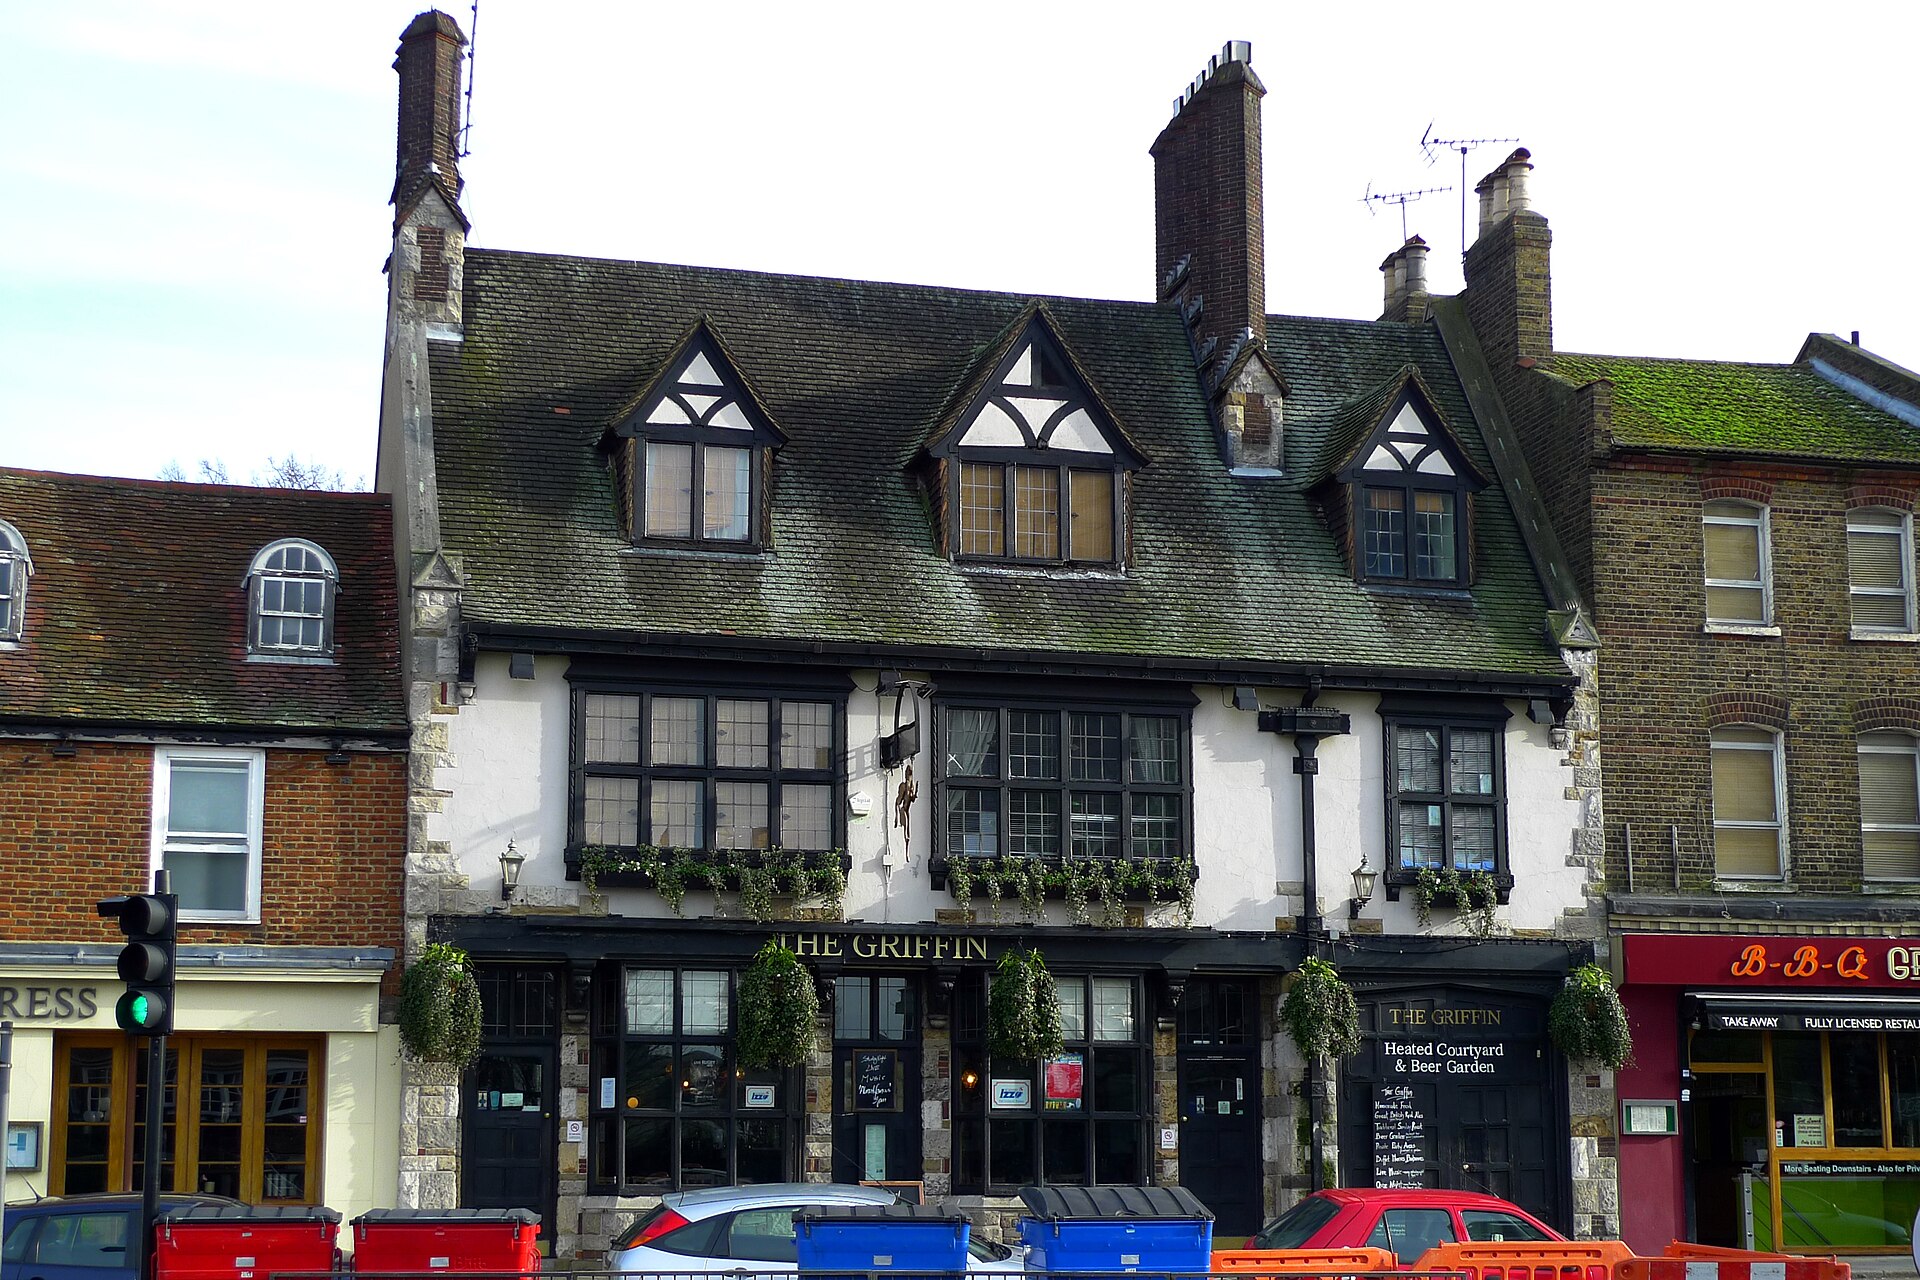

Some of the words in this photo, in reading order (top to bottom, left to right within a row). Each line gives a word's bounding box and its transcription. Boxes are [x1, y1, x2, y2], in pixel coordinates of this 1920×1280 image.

[778, 933, 842, 957] THE
[852, 935, 987, 960] GRIFFIN
[0, 986, 98, 1019] RESS
[1389, 1009, 1426, 1024] THE
[1431, 1009, 1501, 1025] GRIFFIN
[1722, 1016, 1748, 1027] TAKE
[1750, 1017, 1778, 1027] AWAY
[1805, 1018, 1833, 1028] FULLY
[1836, 1018, 1883, 1029] LICENSED
[1384, 1042, 1433, 1055] Heated
[1437, 1043, 1504, 1060] Courtyard
[1395, 1059, 1407, 1072] &
[1411, 1060, 1442, 1073] Beer
[1446, 1060, 1495, 1073] Garden
[1784, 1165, 1802, 1173] More
[1803, 1165, 1831, 1174] Seating
[1832, 1165, 1872, 1173] Downstairs
[1877, 1165, 1894, 1173] Also
[1895, 1165, 1905, 1173] for
